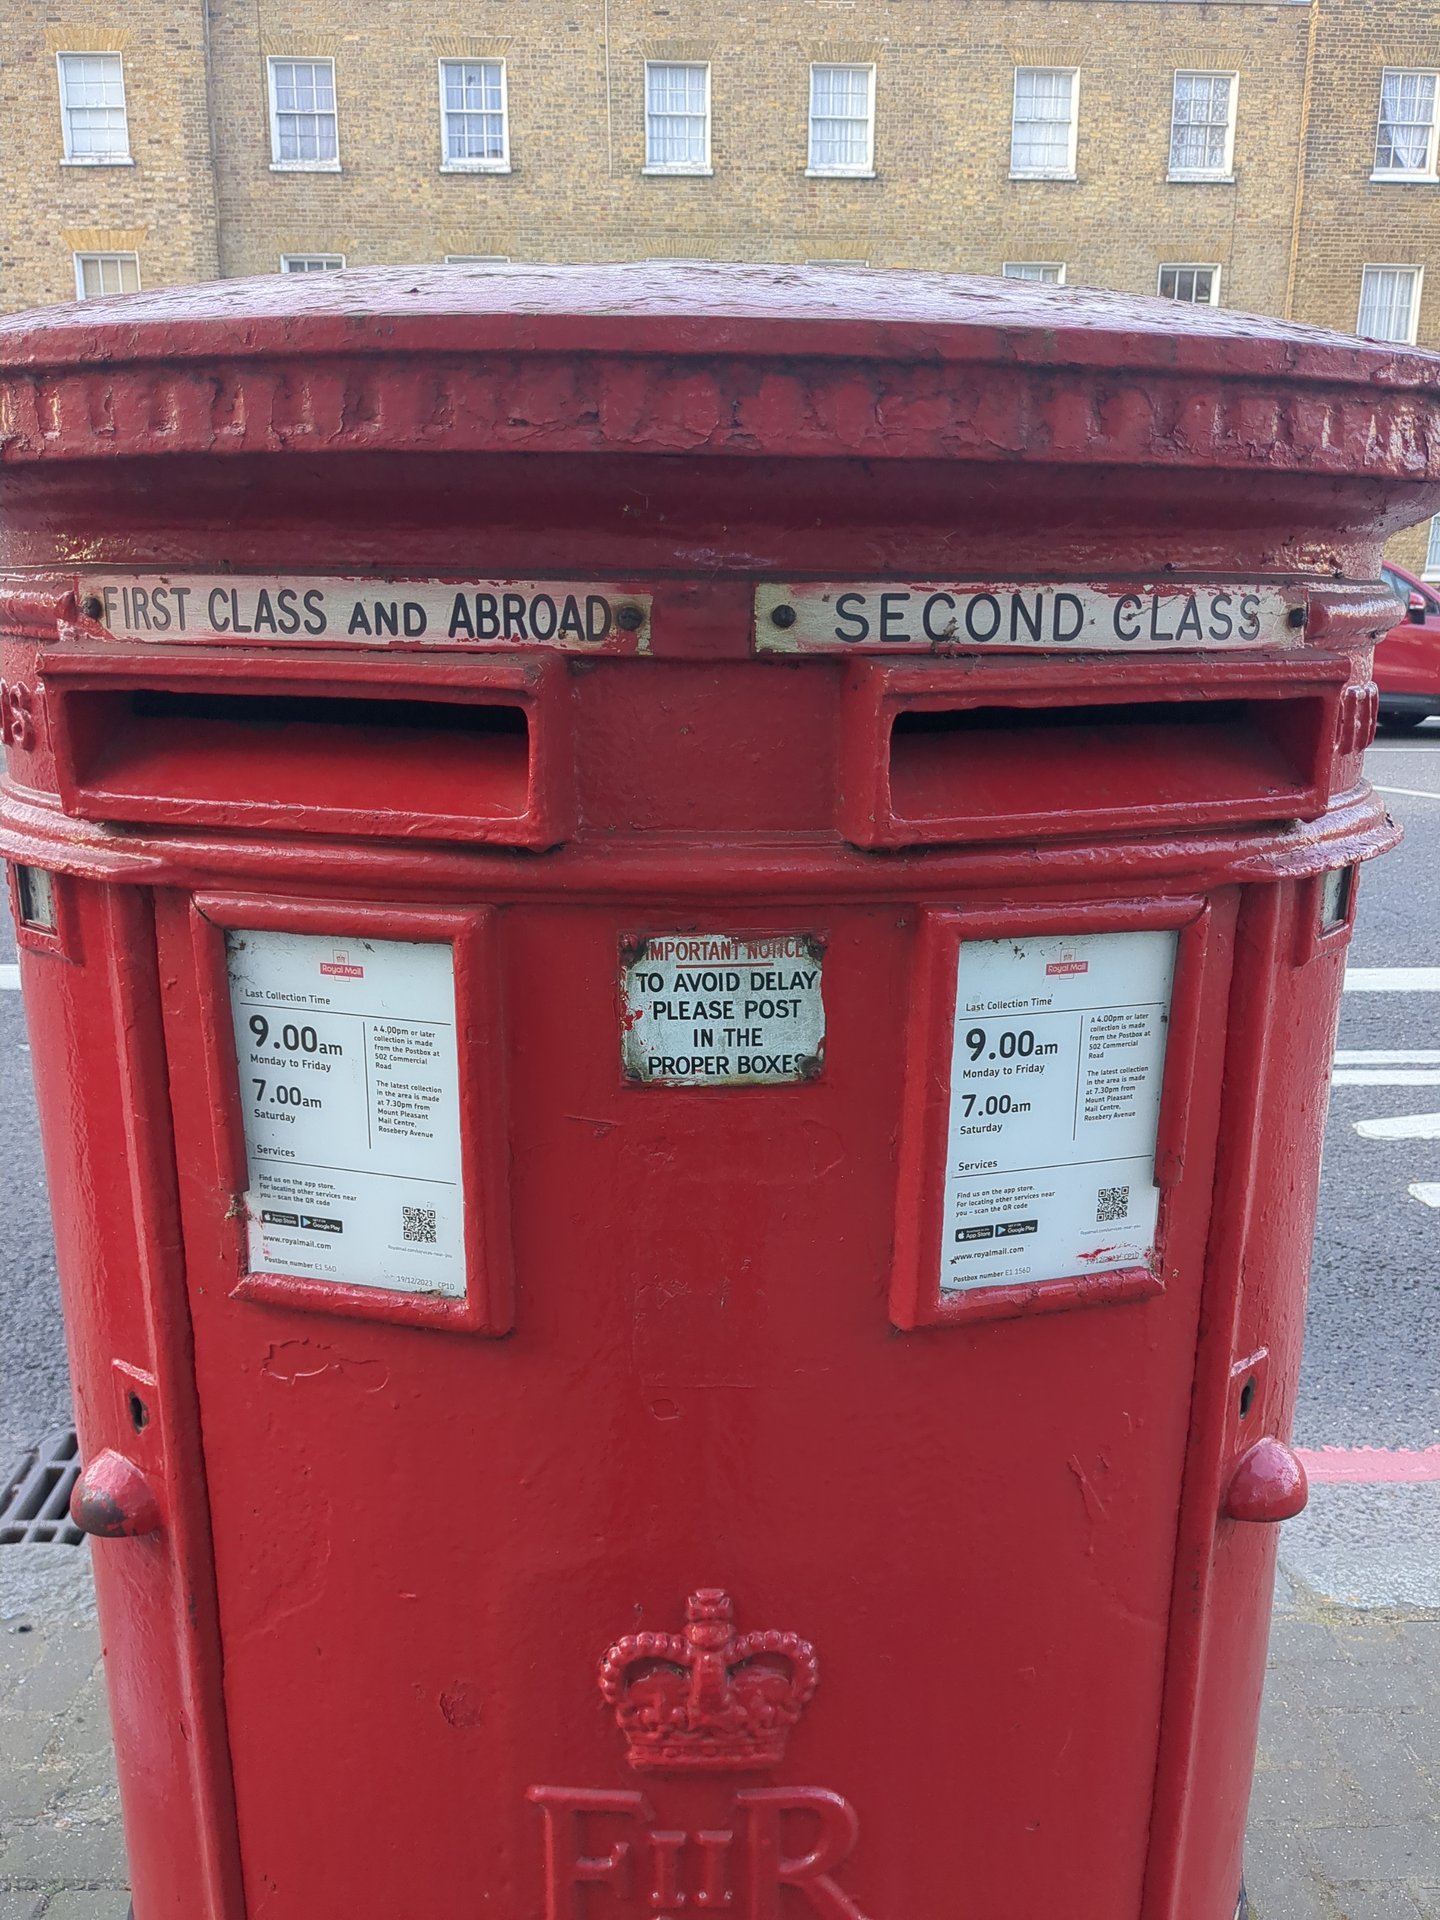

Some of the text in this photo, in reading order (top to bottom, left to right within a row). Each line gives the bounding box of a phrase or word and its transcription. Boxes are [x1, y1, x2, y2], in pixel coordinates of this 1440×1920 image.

[102, 586, 612, 641] FIRST CLASS AND ABROAD
[833, 592, 1262, 644] SECOND CLASS
[645, 940, 803, 961] IMPORTANT NOTICE
[322, 964, 362, 975] Royal Mail
[1048, 962, 1086, 973] Royal Mail
[636, 971, 818, 992] TO AVOID DELAY
[245, 989, 330, 1005] Last Collection Time
[653, 999, 802, 1020] PLEASE POST
[966, 997, 1052, 1011] Last Collection Time
[1097, 1015, 1124, 1023] 4.00pm
[380, 1025, 408, 1035] 4.00pm
[420, 1030, 435, 1038] later
[1090, 1024, 1119, 1032] collection
[249, 1015, 342, 1055] 9.00am
[374, 1035, 405, 1043] collection
[693, 1028, 763, 1047] IN THE
[966, 1028, 1058, 1061] 9.00am
[1103, 1040, 1138, 1049] Commercial
[405, 1047, 431, 1055] Postbox
[250, 1054, 331, 1073] Monday to Friday
[389, 1054, 427, 1064] Commercial
[648, 1056, 730, 1075] PROPER
[963, 1064, 1045, 1079] Monday to Friday
[1120, 1065, 1148, 1074] collection
[252, 1079, 321, 1108] 7.00am
[390, 1082, 409, 1090] latest
[411, 1085, 442, 1093] collection
[1094, 1086, 1119, 1094] 7.30pm
[386, 1099, 412, 1109] 7.30pm
[414, 1103, 430, 1111] from
[962, 1094, 1030, 1117] 7.00am
[254, 1109, 295, 1123] Saturday
[378, 1108, 428, 1120] Mount Pleasant
[394, 1119, 416, 1128] Centre,
[960, 1123, 1002, 1135] Saturday
[379, 1126, 433, 1138] Rosebery Avenue
[257, 1144, 295, 1157] Services
[958, 1160, 997, 1171] Services
[259, 1174, 272, 1182] Find
[271, 1184, 296, 1194] locating
[260, 1192, 271, 1200] you
[969, 1198, 994, 1206] locating
[1014, 1193, 1039, 1201] services
[312, 1221, 341, 1232] Google Play
[263, 1235, 331, 1249] www.royalmail.com
[954, 1247, 1024, 1261] www.royalmail.com
[264, 1256, 289, 1265] Postbox
[953, 1275, 978, 1283] Postbox
